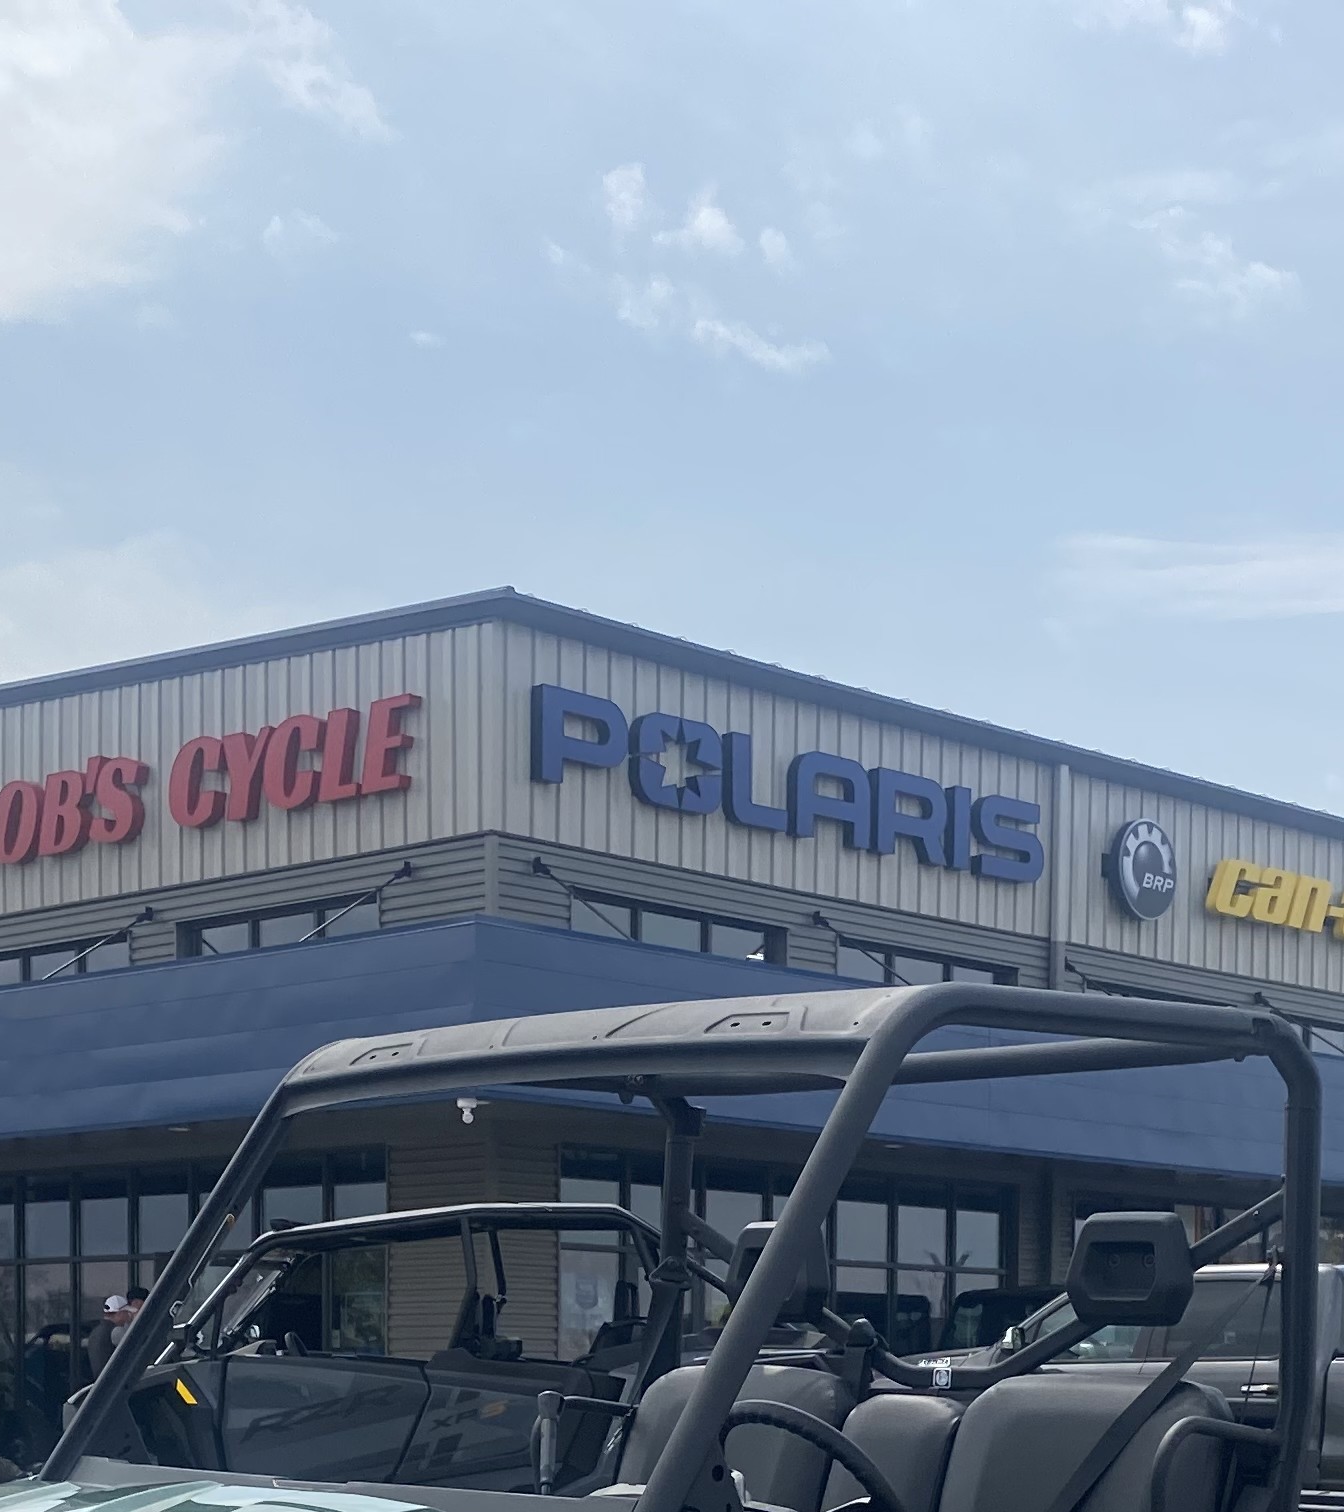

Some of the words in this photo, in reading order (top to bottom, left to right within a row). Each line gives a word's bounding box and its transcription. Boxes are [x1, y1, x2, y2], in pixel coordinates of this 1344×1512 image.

[169, 693, 422, 828] CYCLE
[531, 683, 1045, 884] POLARIS
[1142, 872, 1174, 893] BRP
